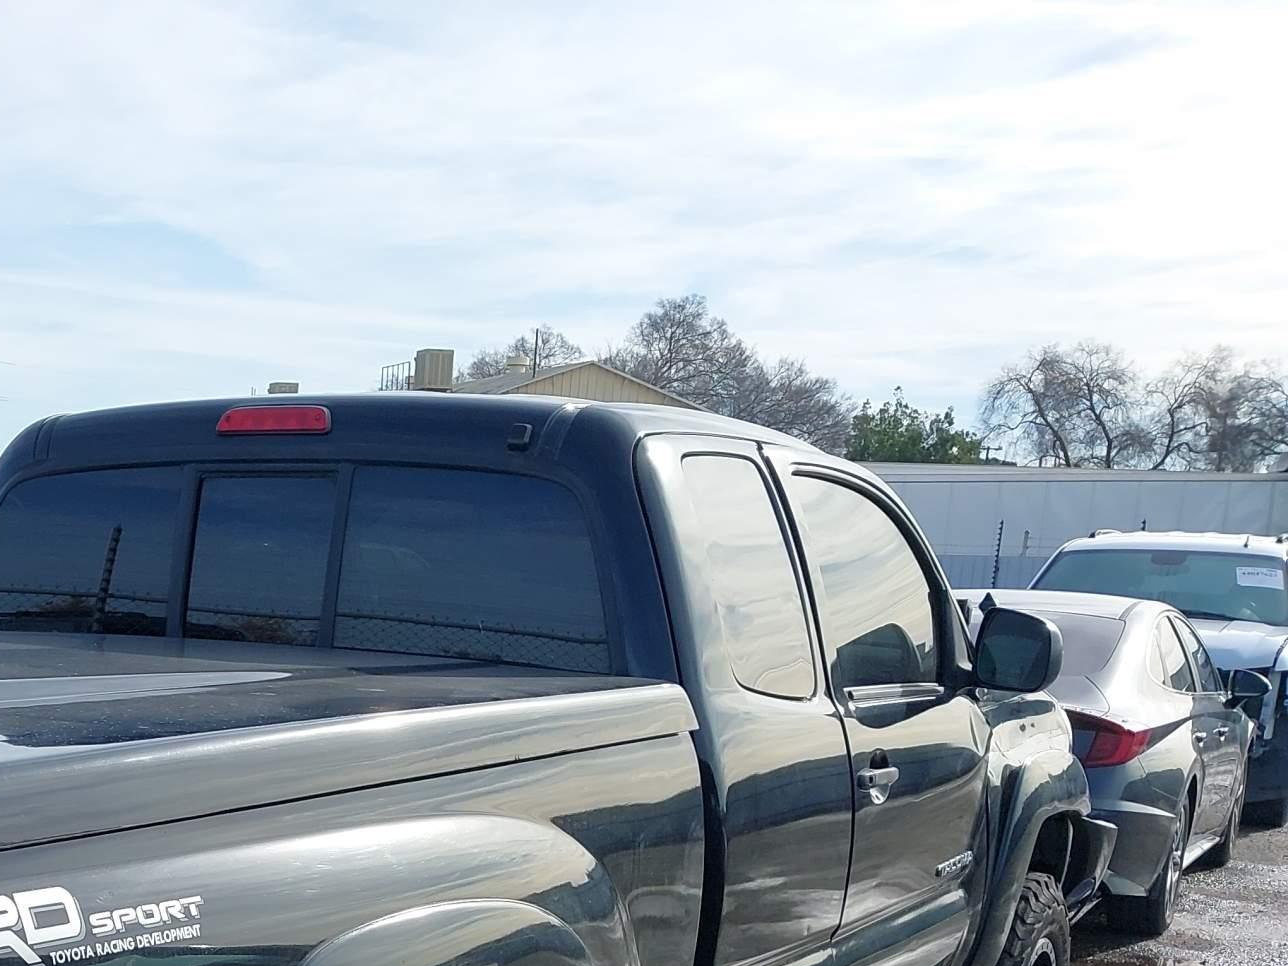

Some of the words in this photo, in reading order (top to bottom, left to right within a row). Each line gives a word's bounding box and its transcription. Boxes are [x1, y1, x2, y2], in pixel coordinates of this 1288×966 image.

[89, 896, 204, 937] SPORT
[50, 945, 95, 965] TOYOTA
[96, 939, 135, 957] RACING
[136, 924, 201, 948] DEVELOPMENT
